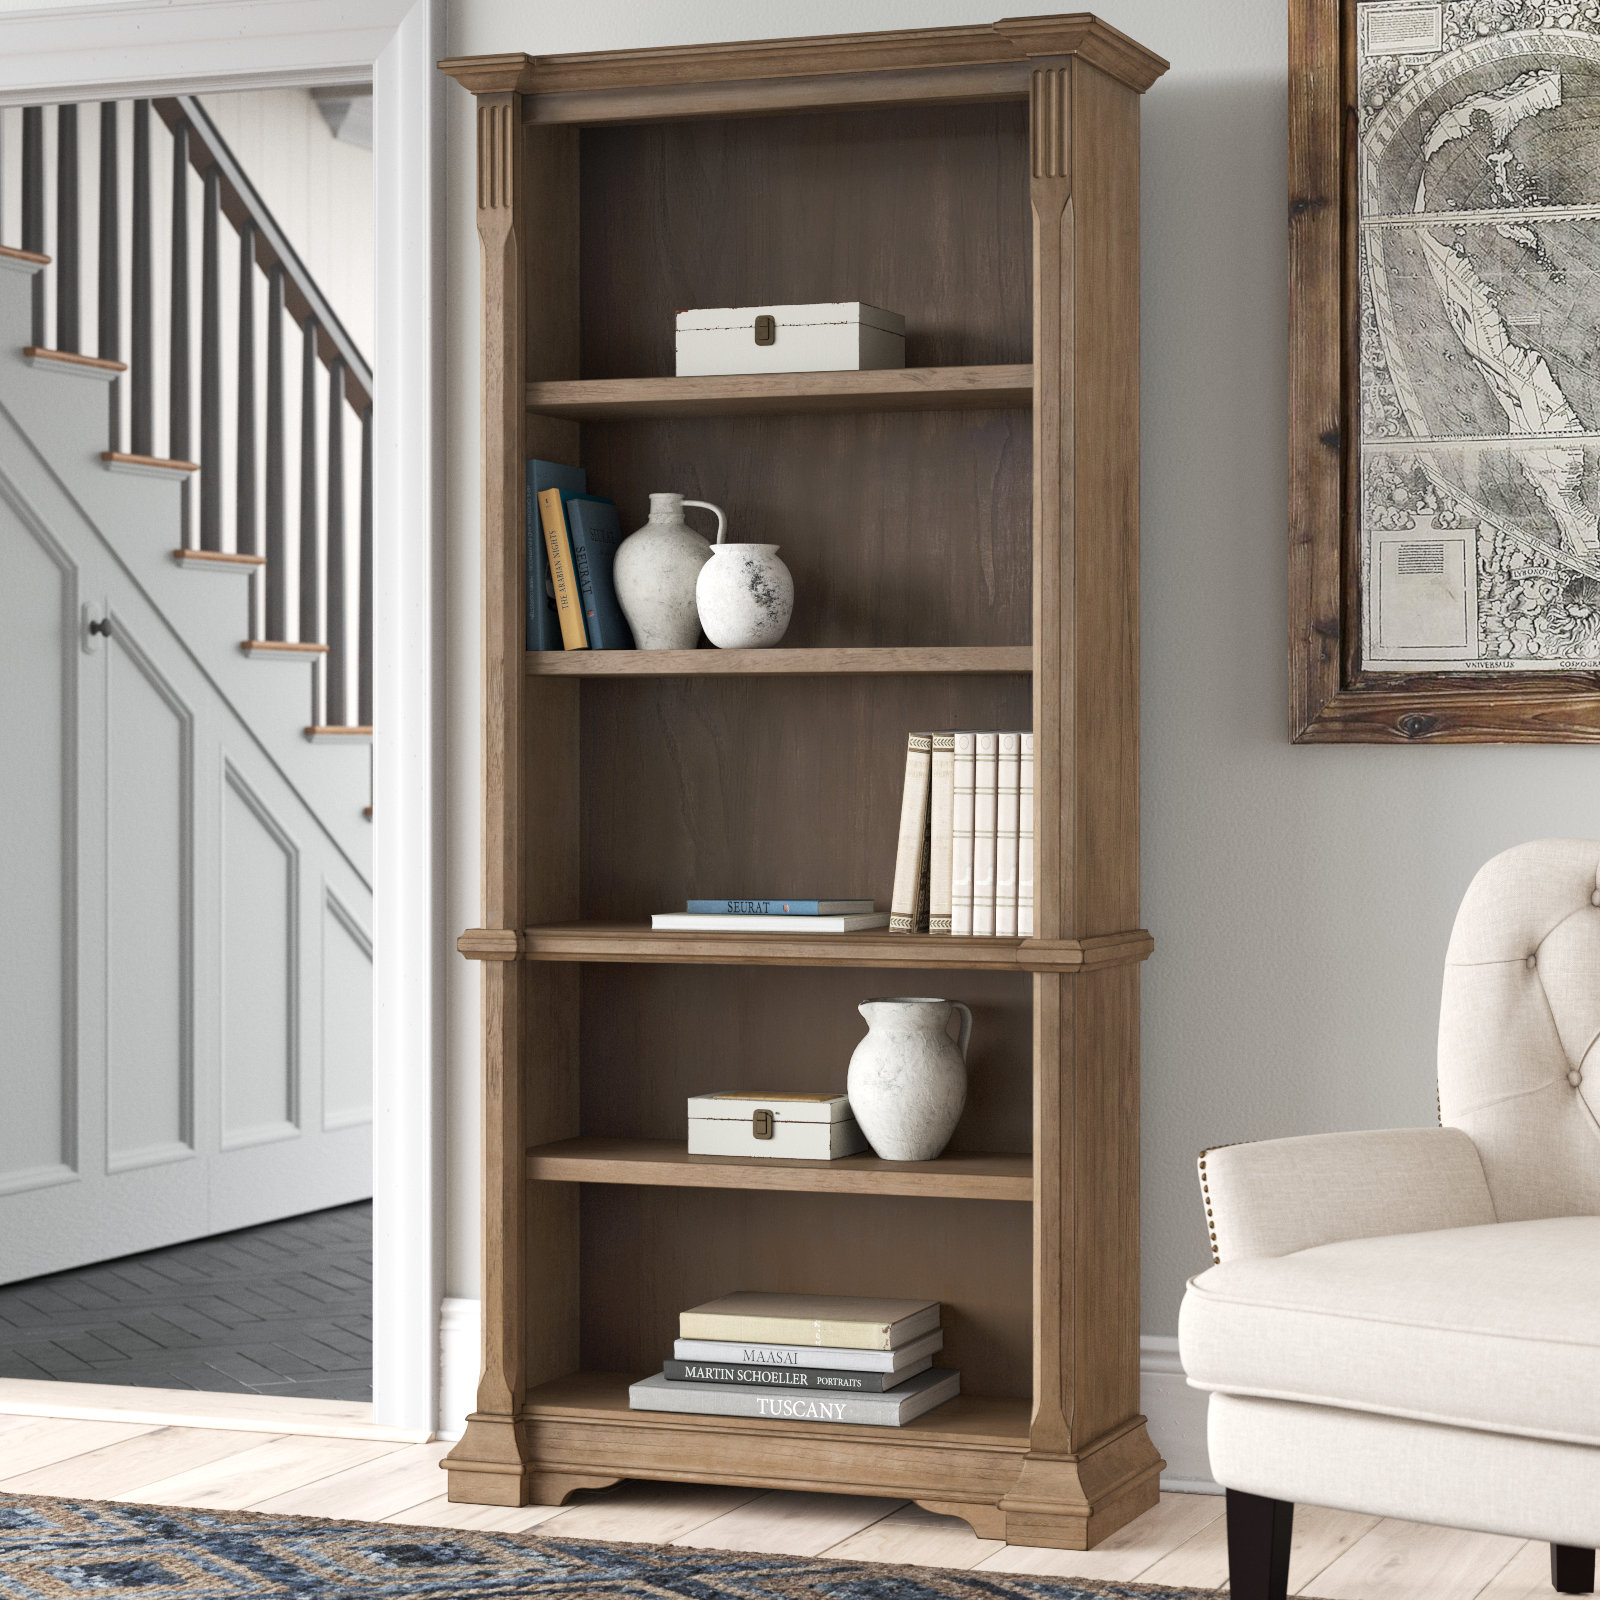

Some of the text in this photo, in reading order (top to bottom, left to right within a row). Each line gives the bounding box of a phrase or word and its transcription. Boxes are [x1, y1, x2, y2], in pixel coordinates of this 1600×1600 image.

[547, 529, 569, 610] THE ARABIAN NIGHTS
[576, 547, 593, 595] SEURAT
[727, 900, 770, 914] SEURAT
[743, 1349, 798, 1364] MAASAI
[684, 1365, 862, 1388] MARTIN SCHOELLER PORTRAITS
[757, 1398, 847, 1420] TUSCANY
